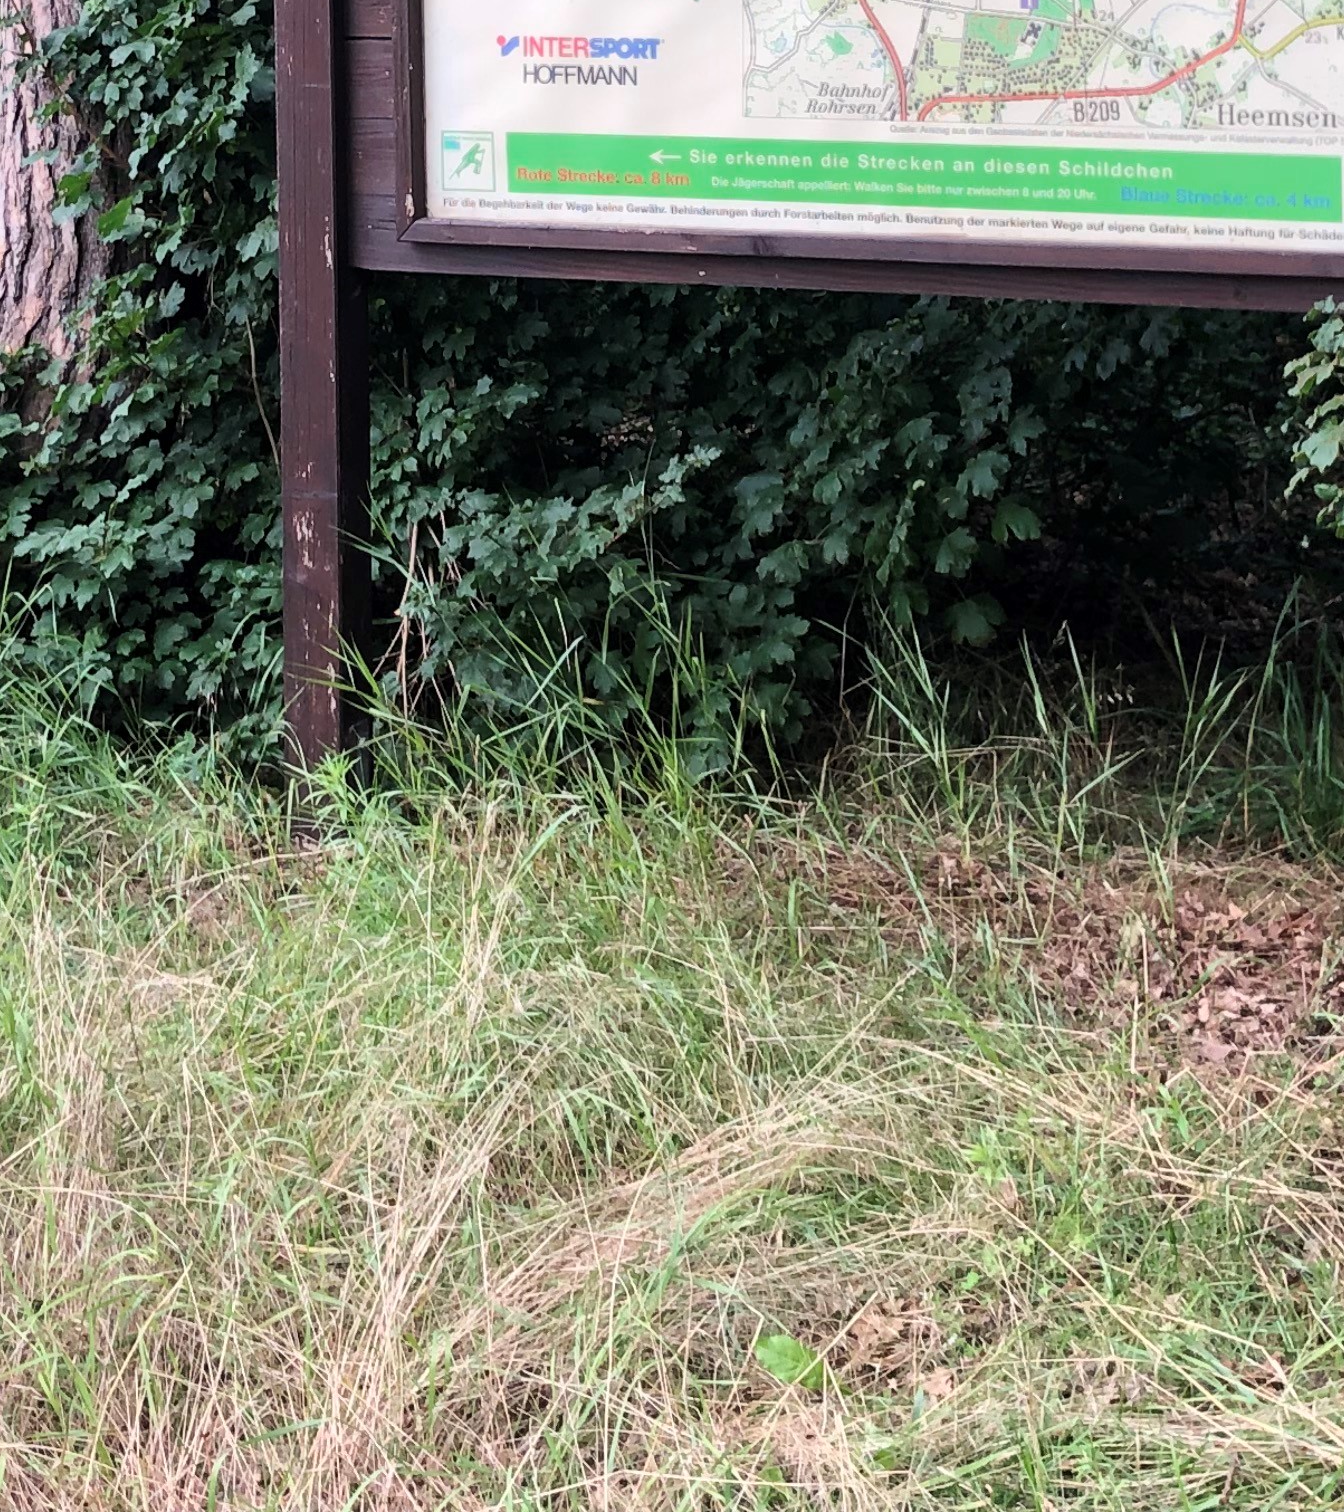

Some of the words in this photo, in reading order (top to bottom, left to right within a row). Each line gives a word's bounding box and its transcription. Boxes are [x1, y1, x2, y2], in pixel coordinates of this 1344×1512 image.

[522, 35, 660, 61] INTERSPORT
[522, 63, 638, 86] HOFFMANN
[816, 81, 893, 100] Bahnhof
[805, 98, 877, 114] Rohrsen
[1216, 103, 1338, 130] Heemsen
[689, 148, 717, 165] Sie
[725, 150, 813, 168] erkennen
[821, 152, 849, 169] die
[857, 153, 945, 171] Strecken
[953, 159, 975, 172] an
[984, 158, 1050, 175] diesen
[1058, 160, 1174, 179] Schildchen
[517, 166, 551, 182] Rote
[557, 167, 620, 184] Strecke:
[624, 172, 647, 185] ca.
[651, 171, 661, 185] 8
[665, 171, 690, 186] km
[711, 176, 729, 187] Die
[731, 176, 795, 190] Jägerschaft
[854, 181, 894, 192] Walken
[896, 182, 914, 193] Sie
[917, 183, 942, 195] bitte
[945, 186, 963, 195] nur
[967, 185, 1020, 197] zwischen
[1032, 188, 1053, 199] und
[1057, 188, 1071, 199] 20
[1120, 185, 1170, 204] Blaue
[1175, 188, 1249, 206] Strecke:
[1255, 194, 1280, 208] ca.
[1287, 192, 1297, 207] 4
[1303, 192, 1331, 209] km
[443, 198, 459, 207] Für
[461, 198, 476, 207] die
[547, 200, 562, 210] der
[566, 201, 593, 213] Wege
[596, 202, 623, 213] keine
[670, 204, 748, 218] Behinderungen
[750, 206, 781, 218] durch
[784, 208, 854, 221] Forstarbeiten
[857, 211, 902, 224] möglich.
[906, 213, 964, 227] Benutzung
[967, 216, 984, 226] der
[988, 217, 1048, 229] markierten
[1052, 220, 1083, 232] Wege
[1086, 221, 1104, 231] auf
[1107, 222, 1145, 234] eigene
[1149, 223, 1189, 236] Gefahr,
[1194, 225, 1224, 237] keine
[1228, 227, 1275, 241] Haftung
[1279, 229, 1295, 240] für
